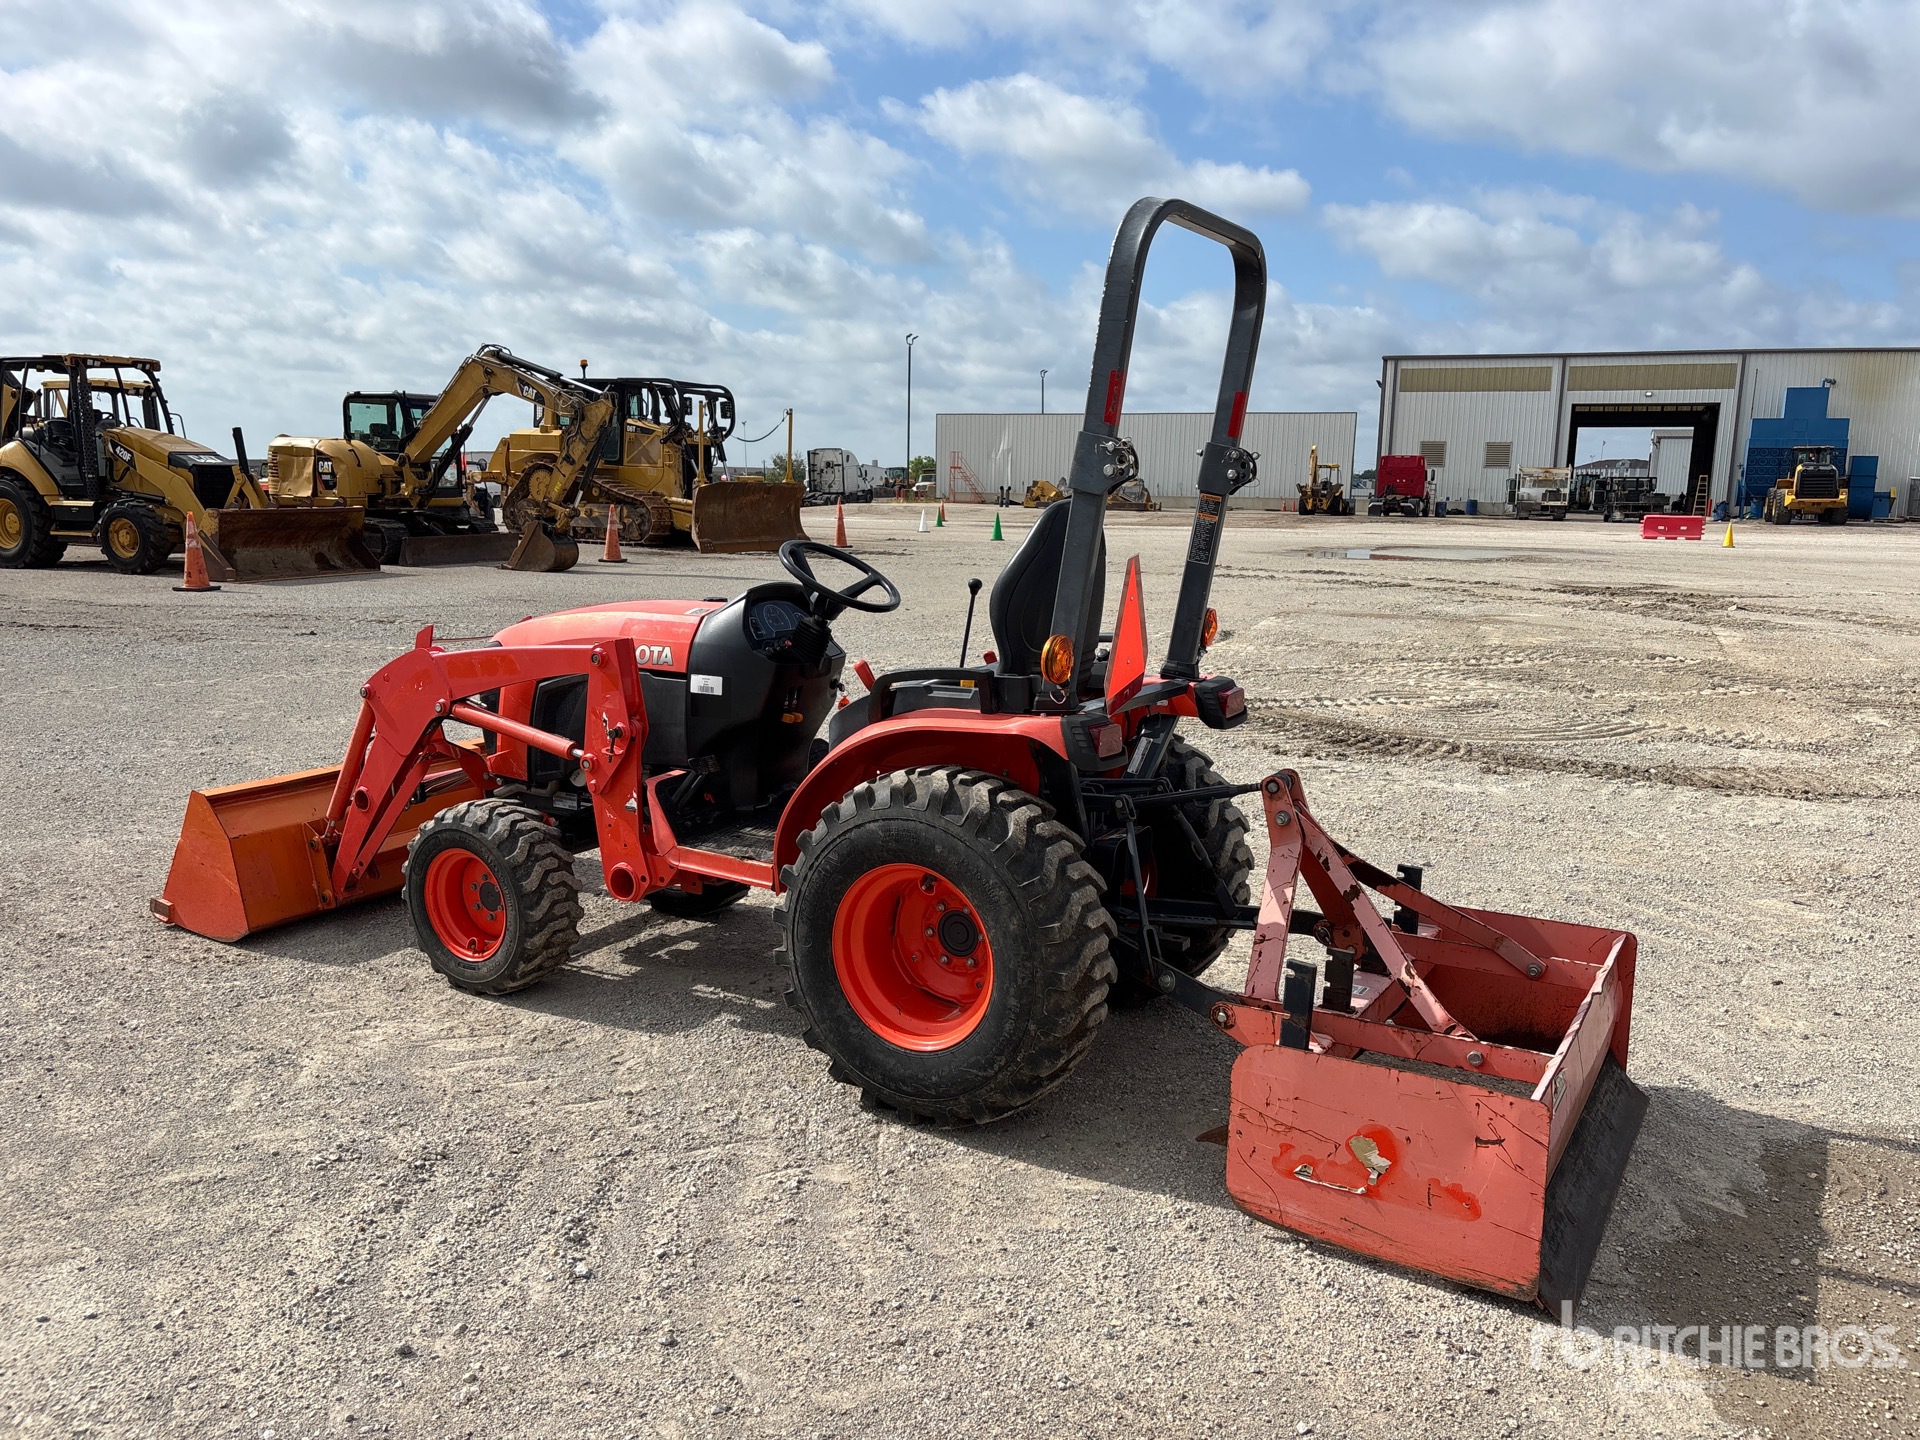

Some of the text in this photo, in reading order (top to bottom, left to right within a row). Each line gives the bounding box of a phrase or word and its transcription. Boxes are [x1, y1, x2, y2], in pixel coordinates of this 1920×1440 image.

[523, 385, 537, 400] CAT
[115, 446, 132, 462] 420F
[318, 461, 333, 473] CAT
[635, 644, 674, 666] OTA
